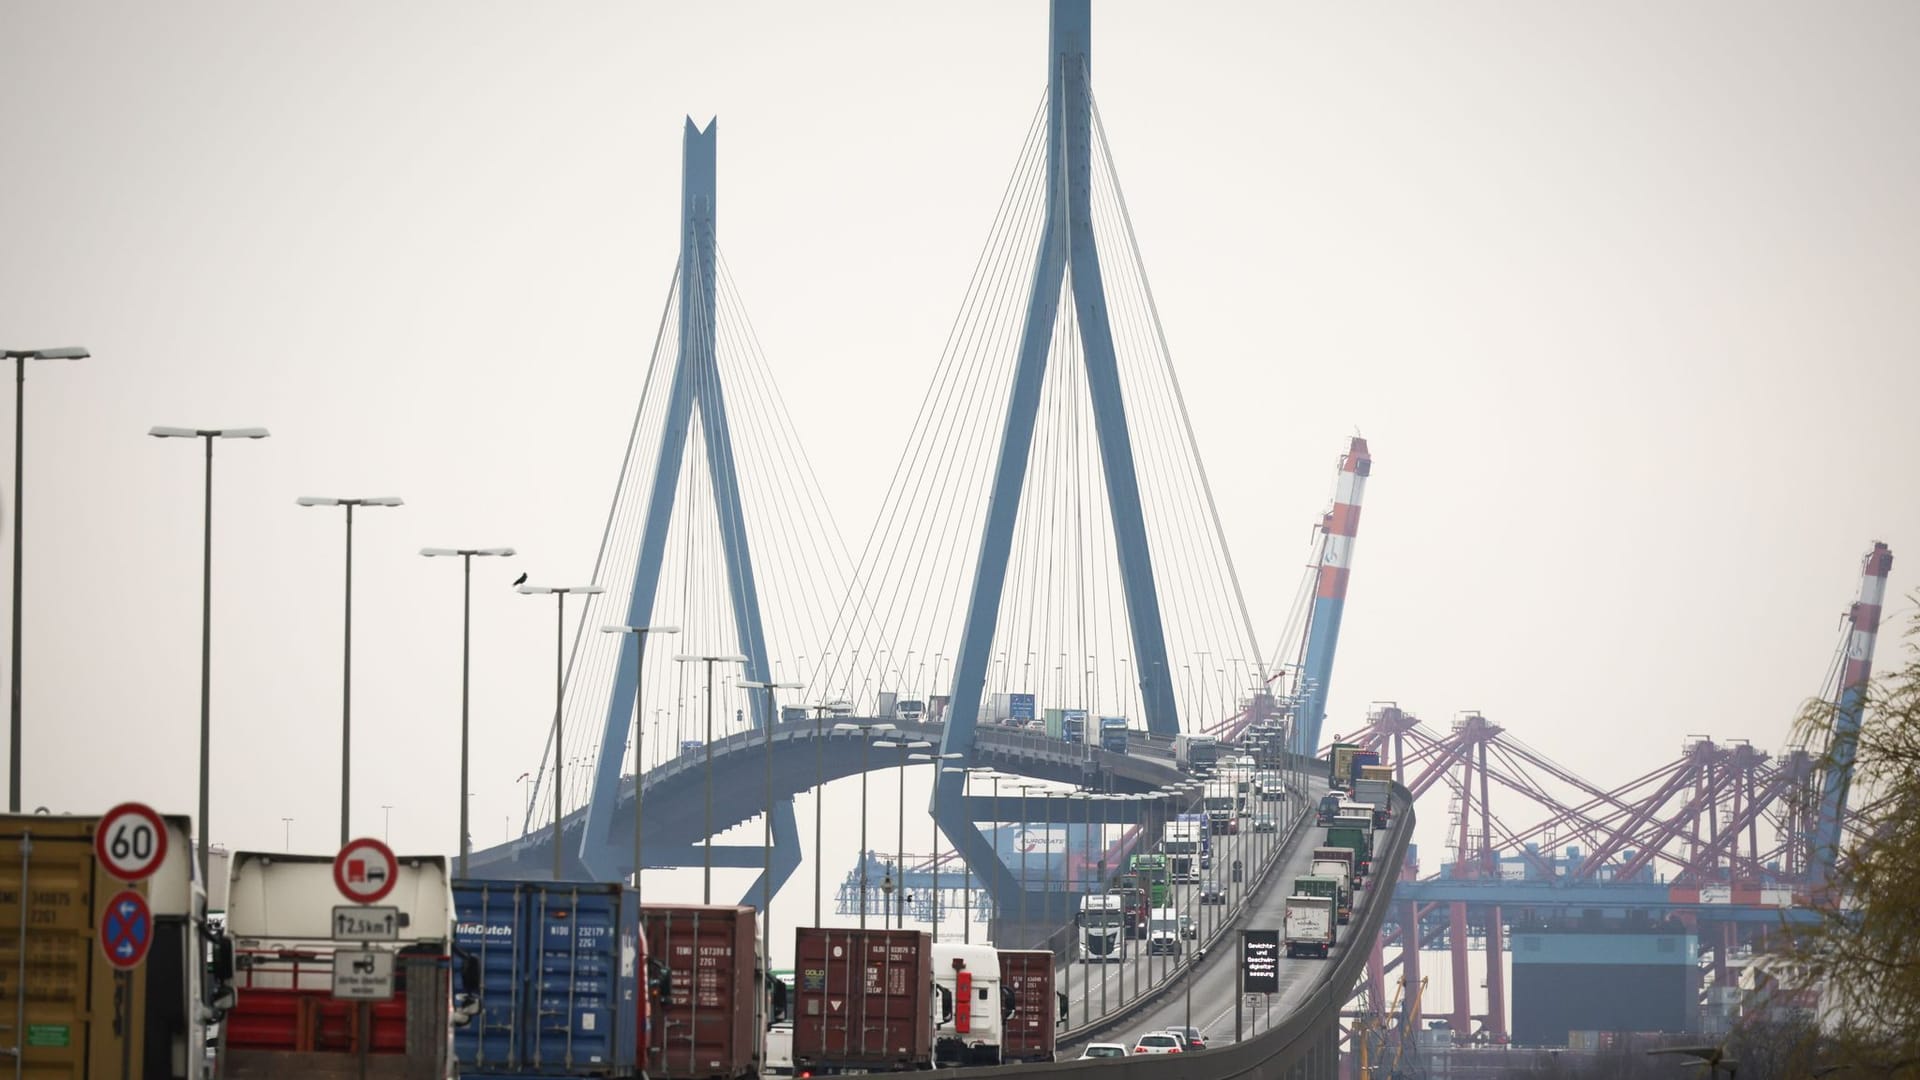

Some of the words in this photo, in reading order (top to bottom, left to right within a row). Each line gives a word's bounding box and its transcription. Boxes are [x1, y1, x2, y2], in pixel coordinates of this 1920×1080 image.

[110, 825, 152, 860] 60
[347, 918, 364, 934] 2,5
[366, 919, 384, 934] km
[578, 938, 596, 948] 22G1
[699, 957, 716, 967] 22G1
[804, 968, 825, 977] GOLD
